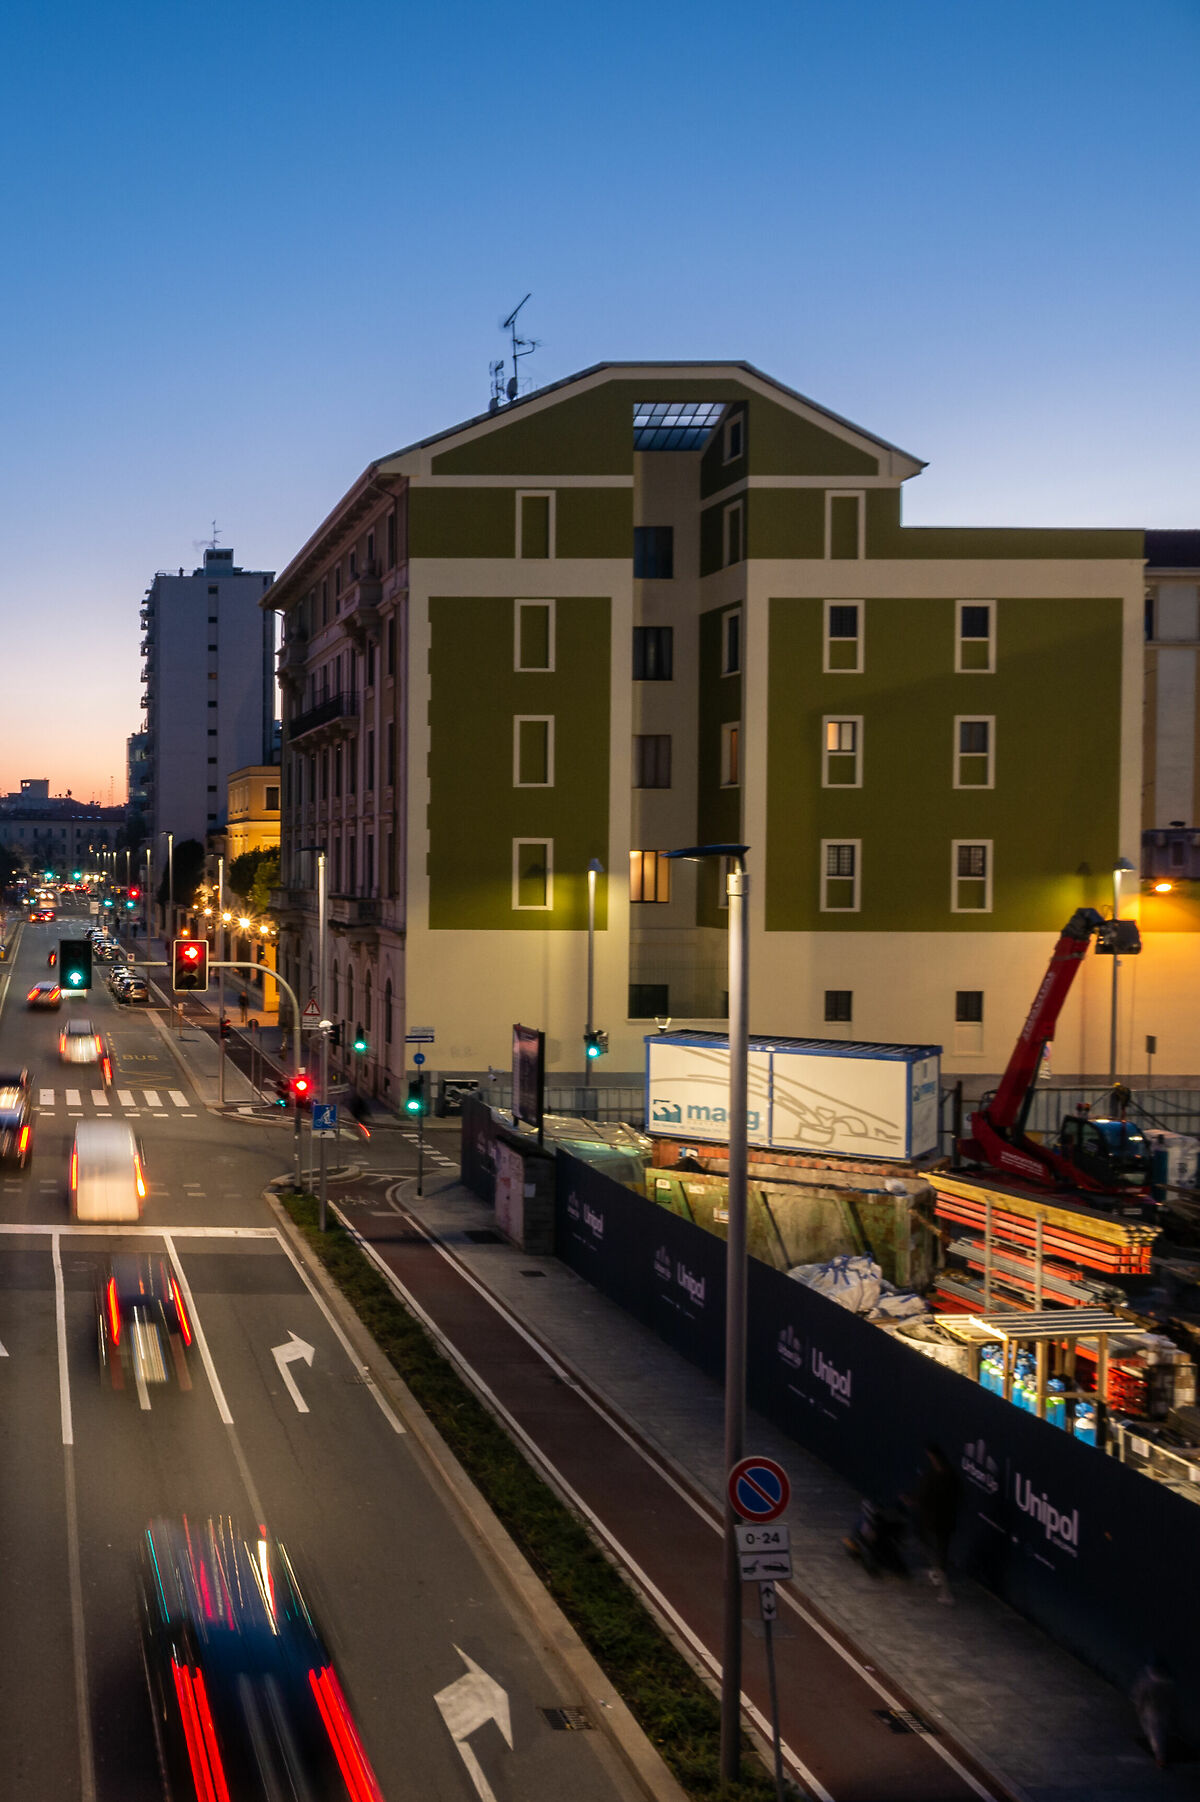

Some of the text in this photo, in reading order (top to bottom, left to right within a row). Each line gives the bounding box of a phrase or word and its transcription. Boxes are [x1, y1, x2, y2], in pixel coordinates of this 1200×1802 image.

[687, 1104, 760, 1131] mag
[677, 1261, 706, 1304] Unipol
[812, 1347, 852, 1398] Unipol
[1015, 1472, 1080, 1546] Unipol
[745, 1532, 780, 1545] 0-24
